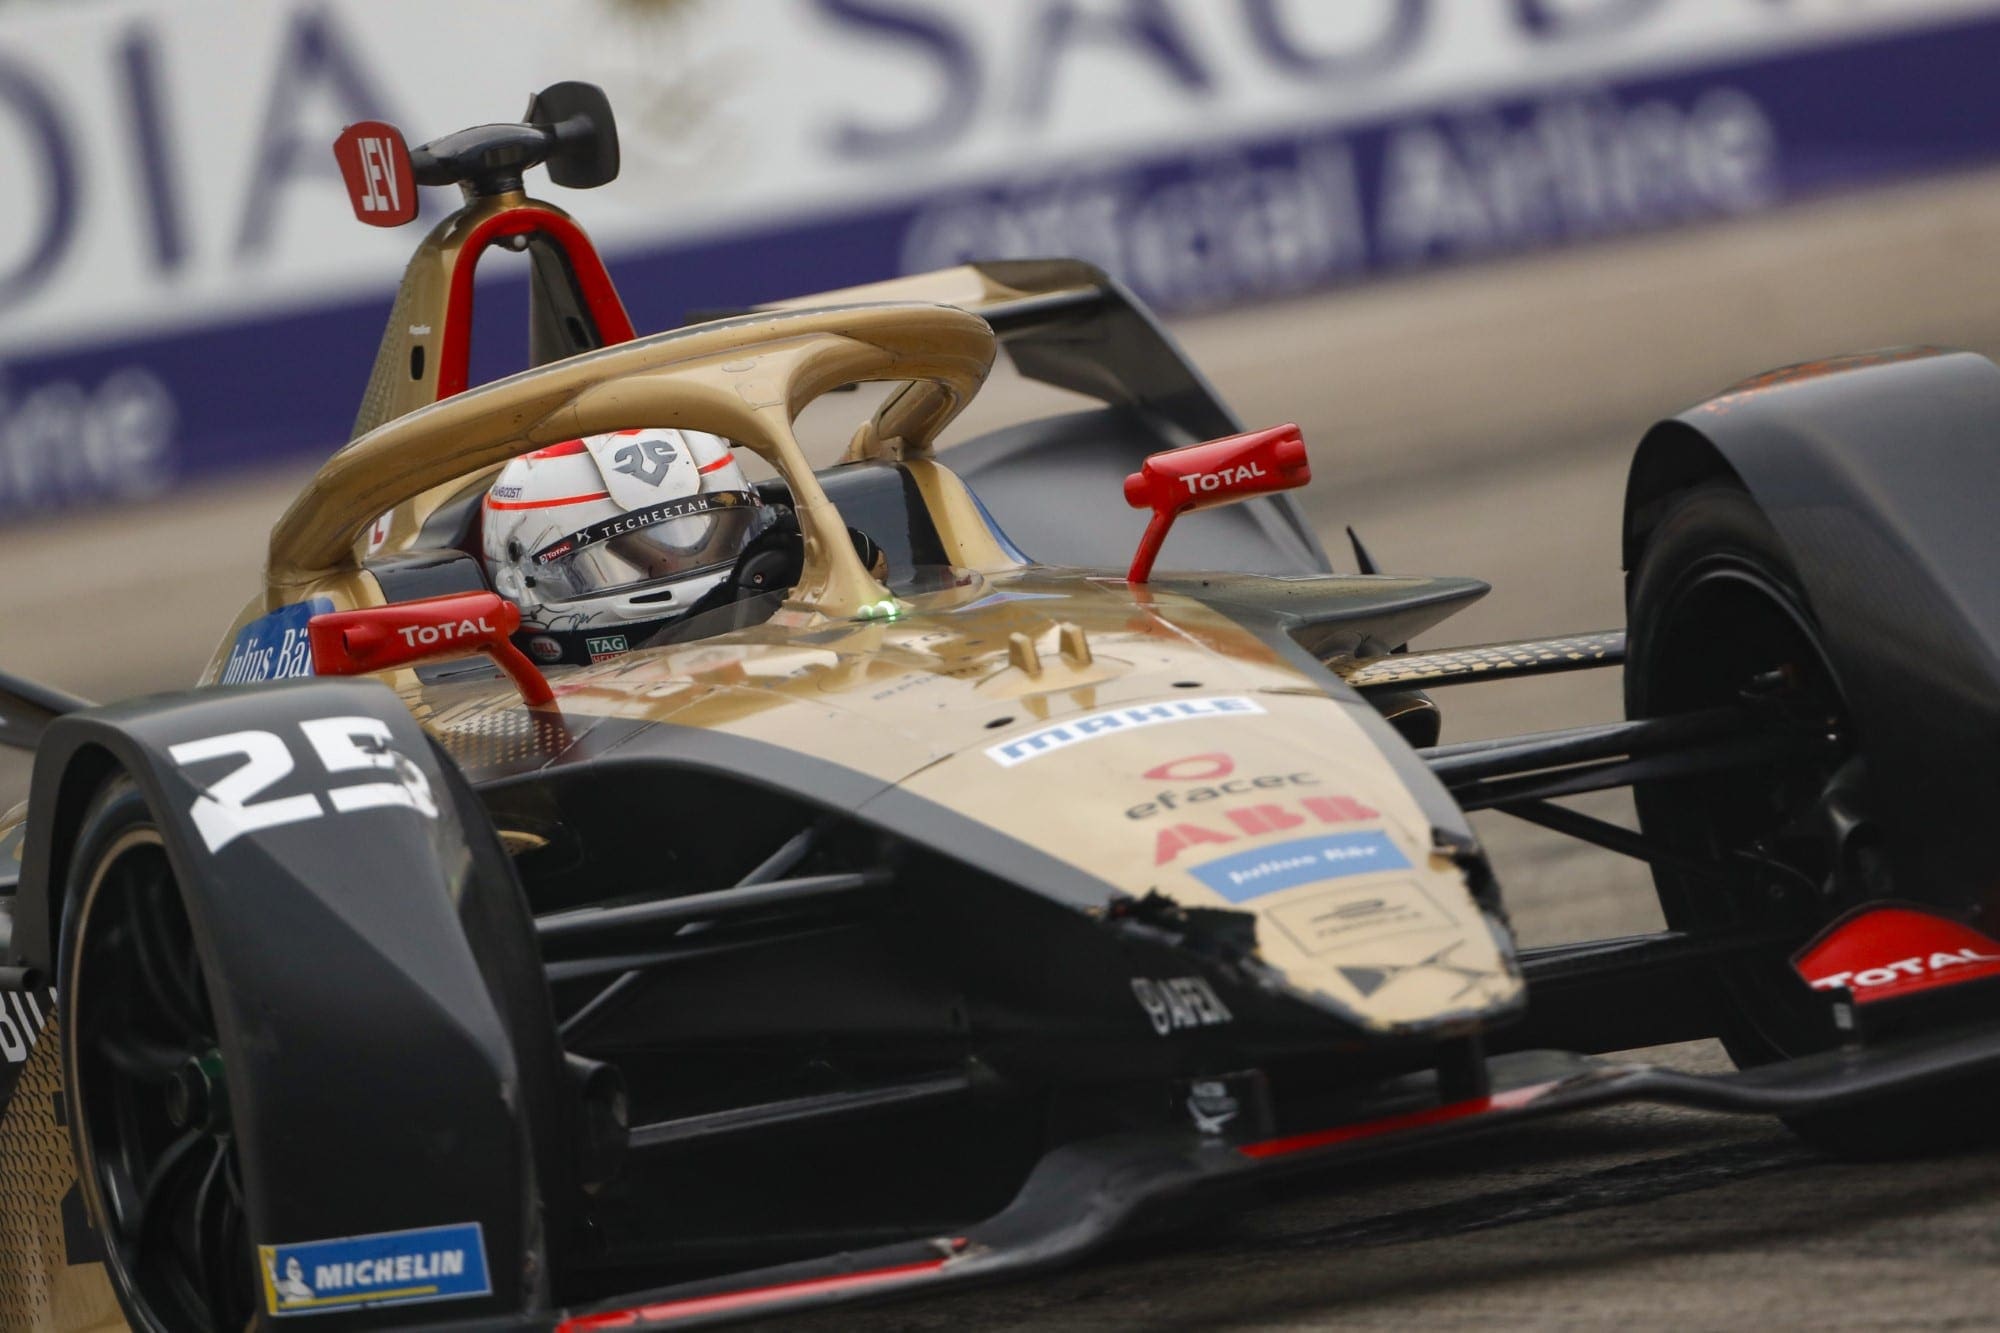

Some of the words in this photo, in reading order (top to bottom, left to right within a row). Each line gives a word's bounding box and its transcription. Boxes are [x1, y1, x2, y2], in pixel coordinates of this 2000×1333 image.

[358, 138, 400, 211] JEV
[1384, 88, 1776, 264] Airline
[1179, 461, 1266, 494] TOTAL
[601, 499, 708, 538] TECHEETAH
[398, 616, 496, 648] TOTAL
[590, 637, 624, 653] TAG
[169, 716, 438, 854] 25
[1125, 772, 1322, 821] efacec
[1154, 796, 1381, 867] ABB
[1810, 948, 2000, 989] TOTAL
[315, 1249, 464, 1290] MICHELIN
